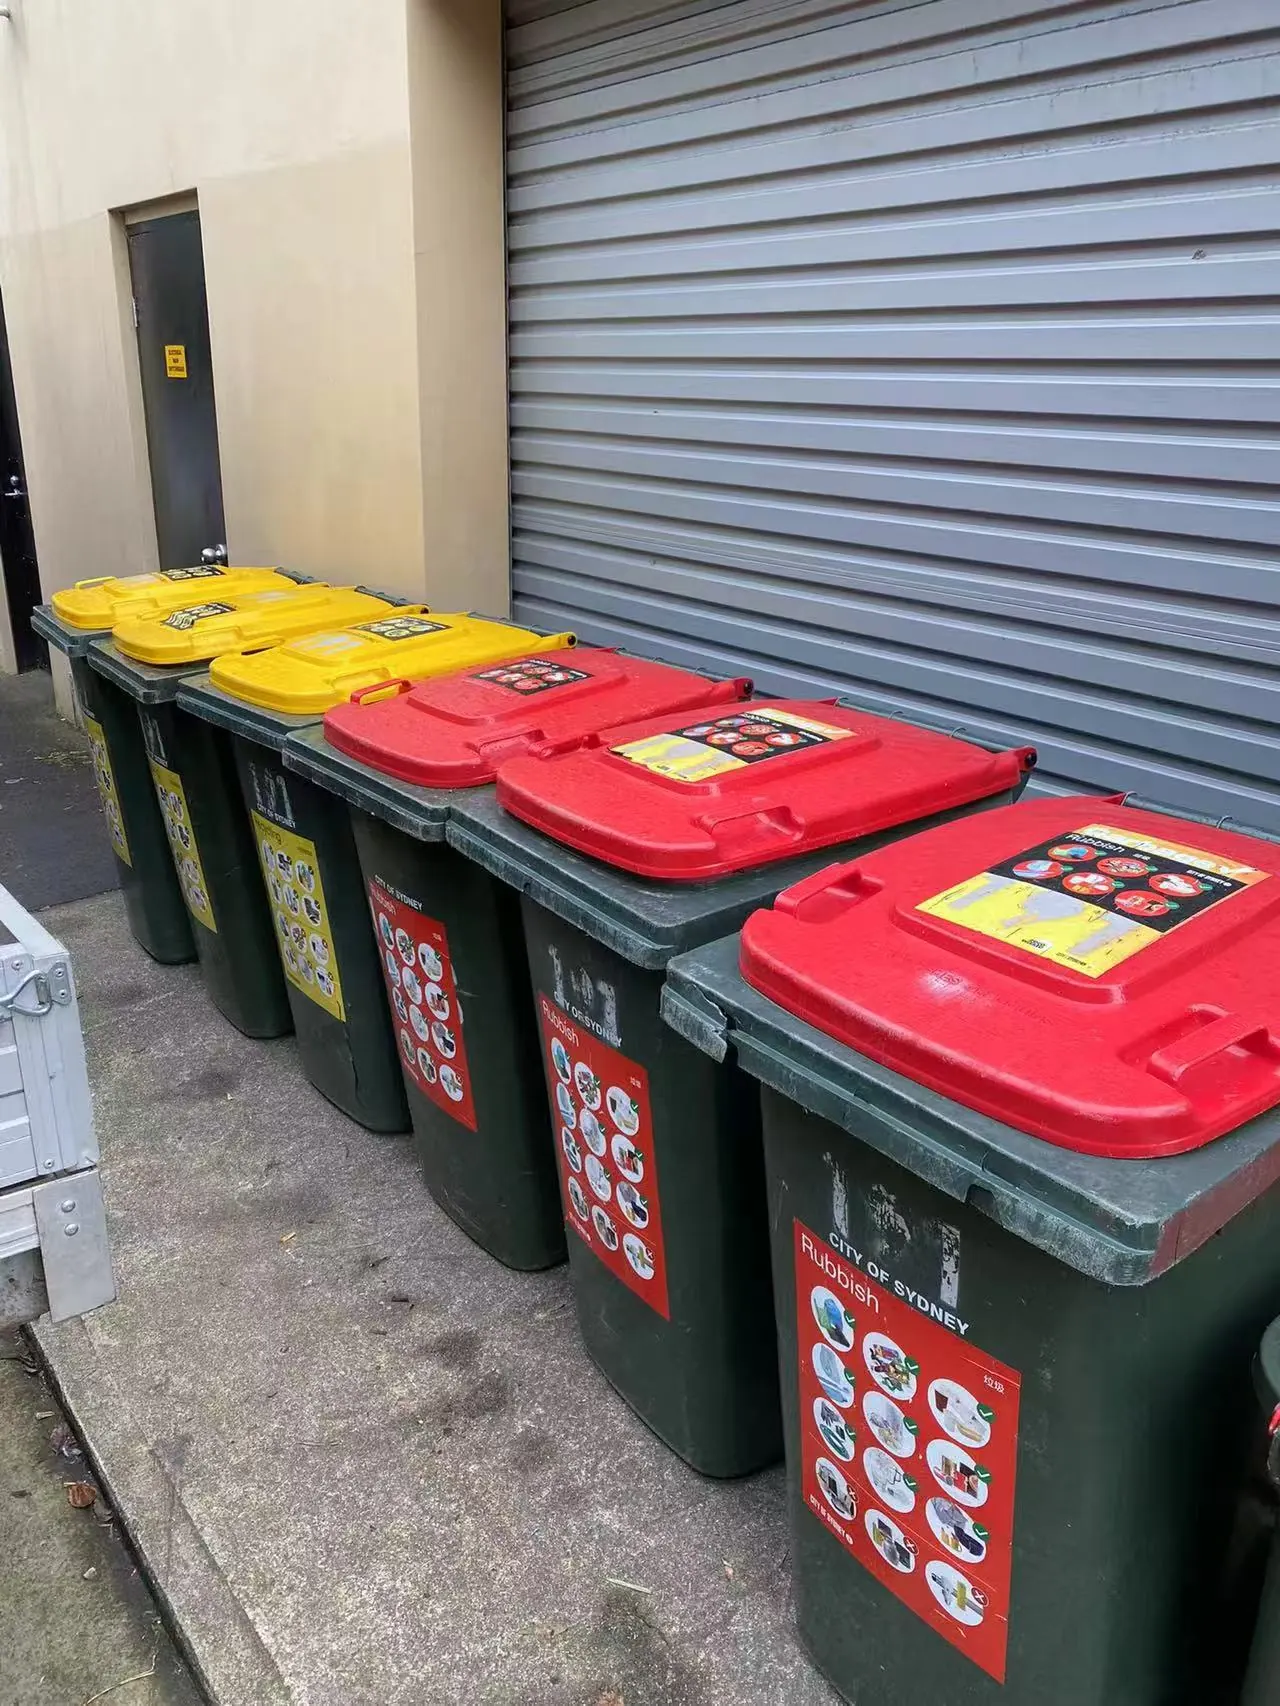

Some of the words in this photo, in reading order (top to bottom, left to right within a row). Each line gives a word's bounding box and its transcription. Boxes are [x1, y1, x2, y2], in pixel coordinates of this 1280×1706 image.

[1065, 834, 1126, 853] Rubbish
[395, 889, 422, 911] SYDNEY
[542, 1000, 579, 1047] Rubbish
[801, 1232, 879, 1314] Rubbish
[829, 1232, 863, 1265] CITY
[867, 1261, 890, 1283] OF
[894, 1279, 970, 1335] SYDNEY
